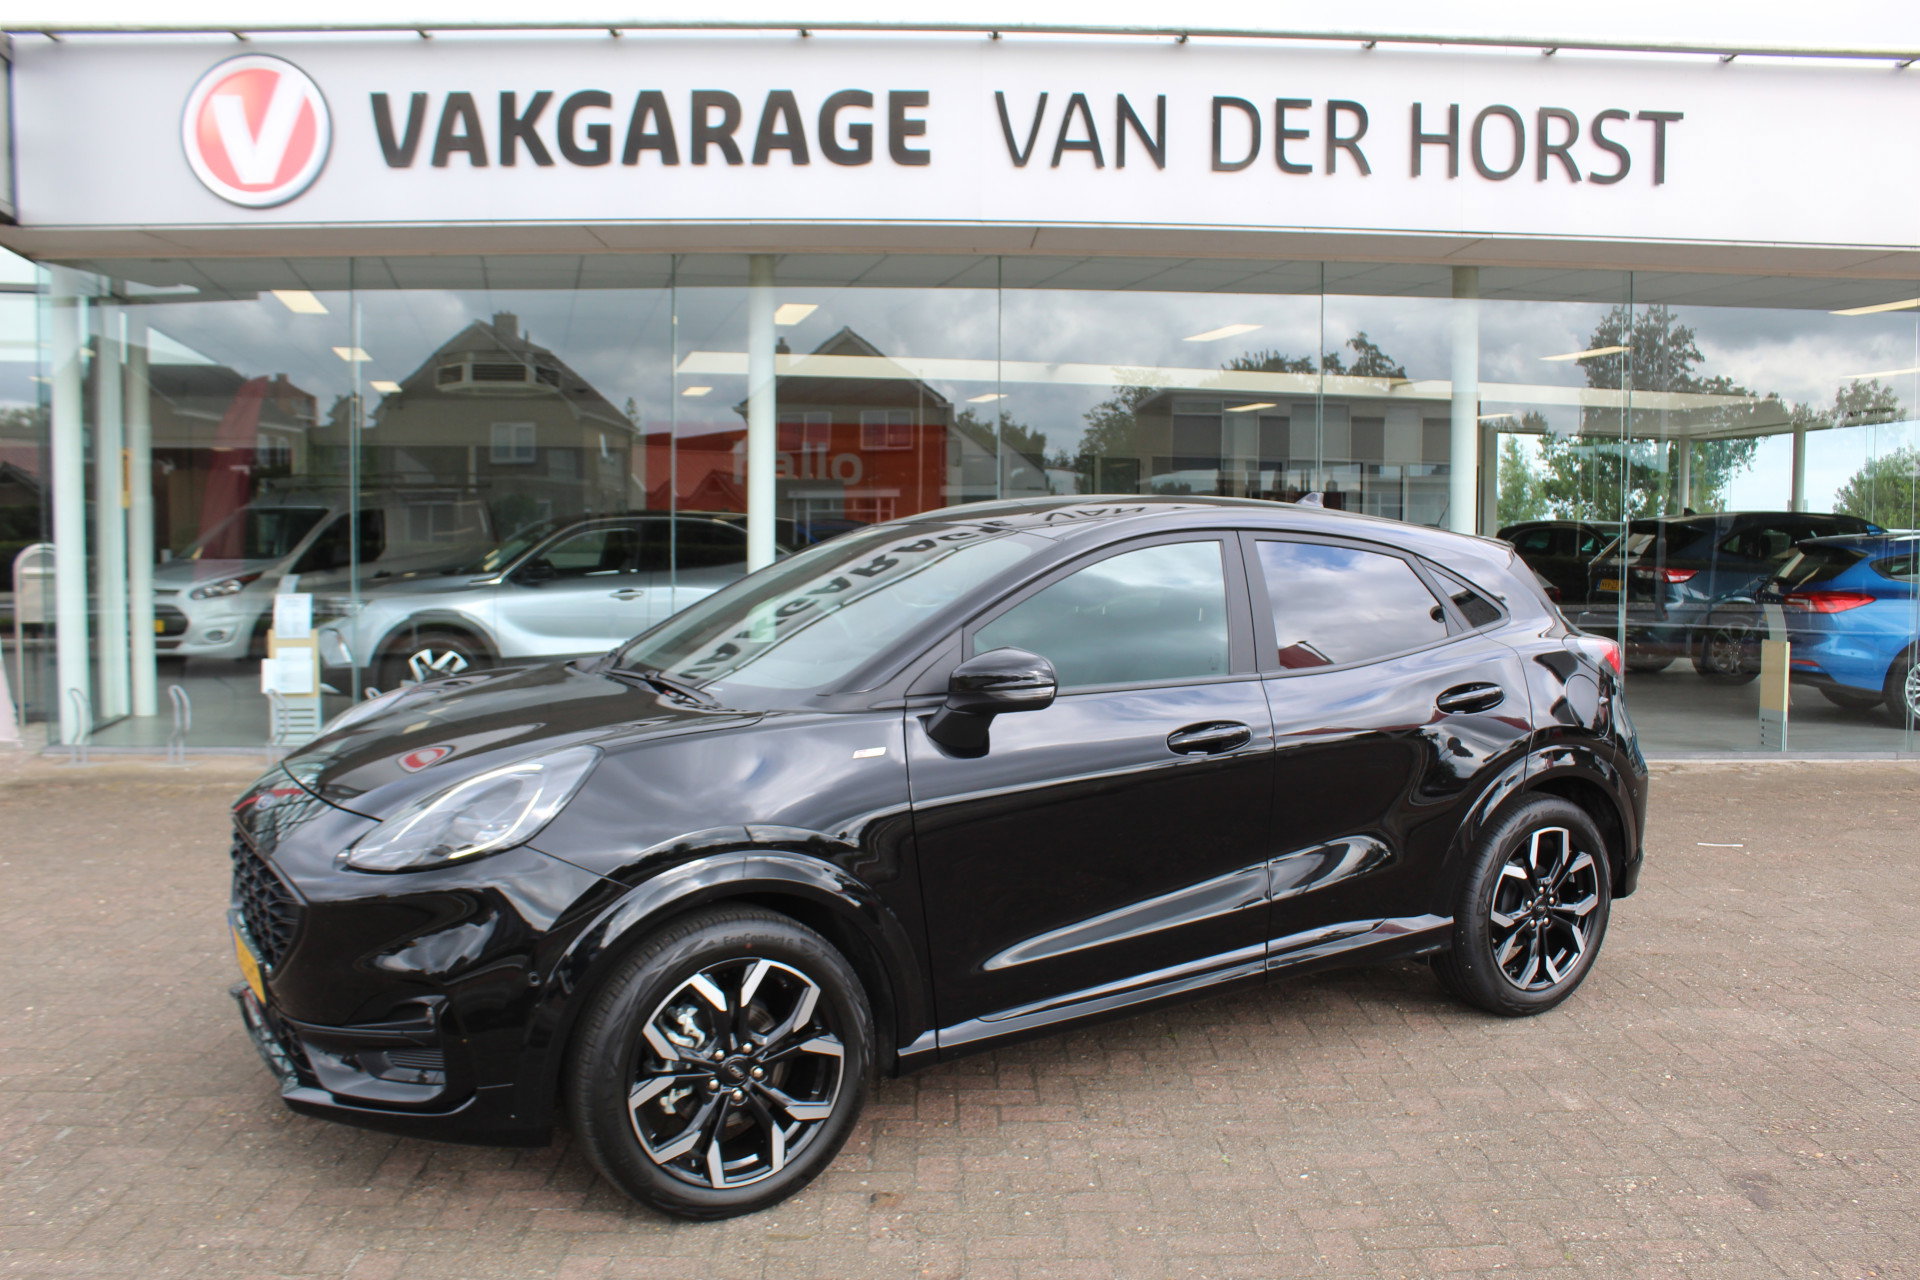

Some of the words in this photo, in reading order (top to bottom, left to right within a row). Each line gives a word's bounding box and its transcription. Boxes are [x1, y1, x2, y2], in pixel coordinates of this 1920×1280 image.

[212, 71, 307, 185] V
[370, 89, 931, 168] VAKGARAGE
[994, 91, 1166, 169] VAN
[1211, 96, 1372, 176] DER
[1411, 102, 1684, 185] HORST
